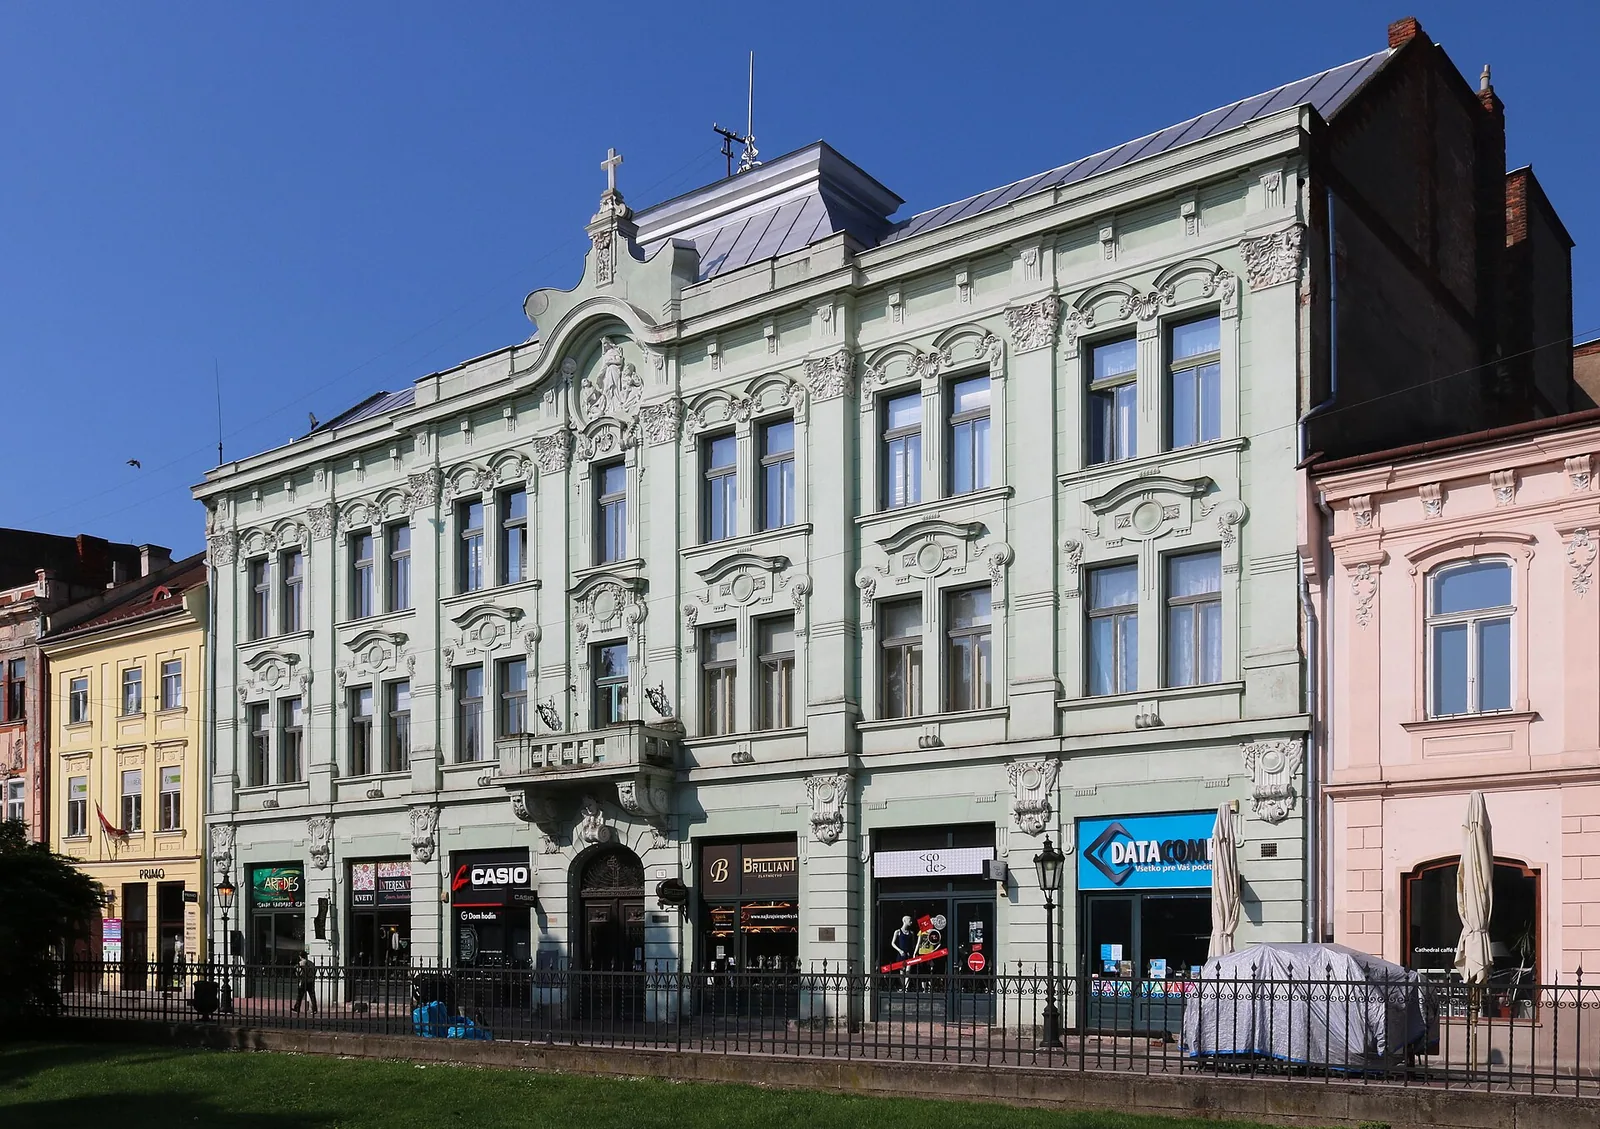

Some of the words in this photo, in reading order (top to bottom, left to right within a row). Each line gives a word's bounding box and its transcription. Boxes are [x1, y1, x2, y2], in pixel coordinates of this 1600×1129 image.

[710, 858, 729, 883] B
[743, 856, 797, 873] BRILLIANT
[1135, 864, 1161, 872] Všetko
[1162, 865, 1175, 873] pre
[1177, 863, 1190, 871] Váš
[139, 868, 165, 880] PRIMO
[471, 867, 528, 885] CASIO
[354, 894, 374, 902] KVETY
[468, 912, 481, 920] Dom
